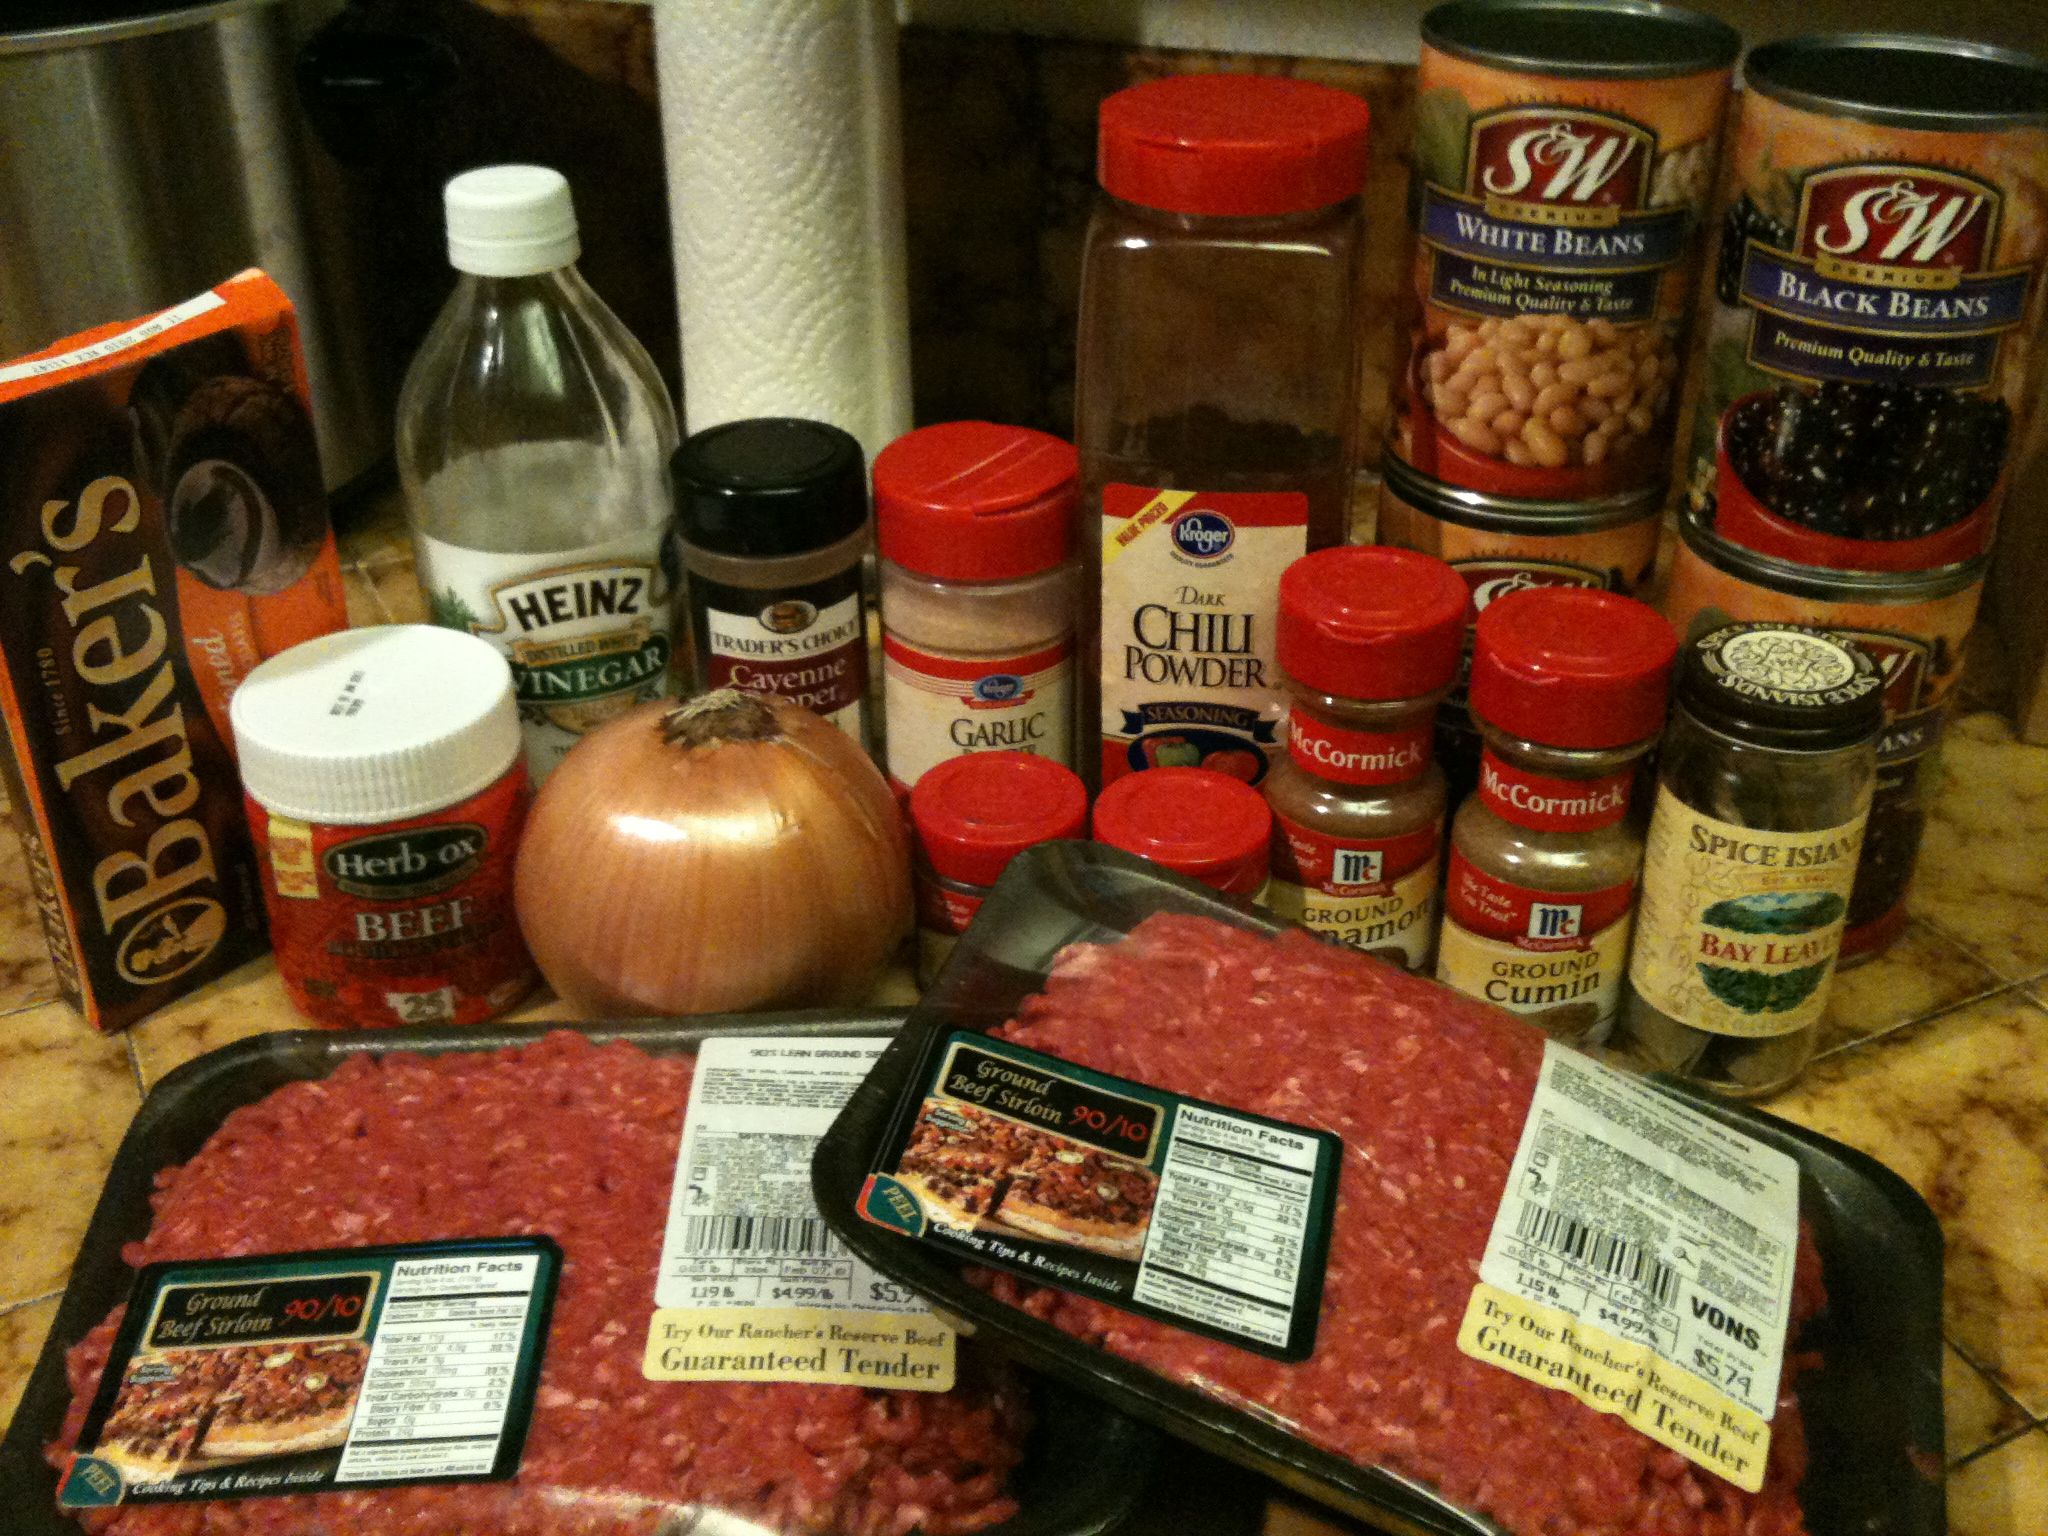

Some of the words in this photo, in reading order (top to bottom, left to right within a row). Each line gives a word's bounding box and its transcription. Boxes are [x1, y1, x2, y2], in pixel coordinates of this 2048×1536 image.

[1483, 122, 1638, 201] S&W
[1456, 211, 1546, 253] WHITE
[1553, 229, 1646, 255] BEANS
[1814, 179, 1984, 262] S&W
[1450, 279, 1511, 304] Premium
[1516, 294, 1574, 312] Quality
[1490, 268, 1530, 291] Light
[1535, 276, 1614, 295] Seasoning
[1777, 271, 1881, 316] BLACK
[1887, 291, 1990, 319] BEANS
[1774, 330, 1843, 360] Premium
[1848, 346, 1915, 369] Quality
[1179, 517, 1229, 553] Kroger
[508, 577, 643, 632] HEINZ
[714, 632, 798, 655] TRADER'S
[1133, 603, 1255, 654] CHILI
[731, 656, 847, 693] Cayenne
[1123, 645, 1266, 689] POWDER
[10, 476, 220, 936] Baker's
[1147, 704, 1249, 728] SEASONING
[950, 712, 1045, 747] GARLIC
[1290, 719, 1423, 771] McCormick
[1483, 761, 1625, 816] McCormick
[335, 842, 428, 878] Herb
[438, 836, 478, 866] ox
[1690, 824, 1779, 867] SPICE
[355, 897, 473, 942] BEEF
[1302, 896, 1404, 924] GROUND
[1492, 951, 1600, 980] GROUND
[1701, 932, 1757, 962] BAY
[1484, 972, 1601, 1005] Cumin
[815, 1050, 861, 1058] GROUND
[977, 1059, 1055, 1097] Ground
[950, 1073, 997, 1103] Beef
[996, 1090, 1063, 1125] Sirloin
[1068, 1106, 1148, 1142] 90/10
[1180, 1109, 1253, 1138] Nutrition
[1258, 1129, 1304, 1150] Facts
[882, 1185, 917, 1223] PEEL
[397, 1263, 471, 1277] Nutrition
[477, 1261, 523, 1273] Facts
[933, 1222, 986, 1251] Cooking
[989, 1240, 1016, 1260] Tips
[1033, 1254, 1081, 1280] Recipes
[1082, 1270, 1122, 1292] Inside
[185, 1286, 270, 1316] Ground
[281, 1293, 365, 1326] 90/10
[690, 1286, 719, 1298] 1.19
[772, 1287, 834, 1300] $4.99/lb
[158, 1315, 207, 1344] Beef
[206, 1313, 273, 1335] Sirloin
[663, 1323, 692, 1343] Try
[699, 1323, 734, 1339] Our
[739, 1323, 824, 1341] Rancher's
[829, 1324, 898, 1343] Reserve
[905, 1329, 947, 1347] Beef
[1691, 1295, 1760, 1351] VONS
[661, 1347, 826, 1373] Guaranteed
[839, 1349, 940, 1379] Tender
[1485, 1297, 1514, 1325] Try
[1519, 1313, 1555, 1342] Our
[1561, 1325, 1645, 1378] Rancher's
[1647, 1365, 1716, 1418] Reserve
[1719, 1411, 1760, 1446] Beef
[1694, 1348, 1752, 1397] $5.74
[1478, 1325, 1643, 1415] Guaranteed
[1652, 1398, 1750, 1474] Tender
[132, 1478, 186, 1497] Cooking
[188, 1476, 217, 1492] Tips
[234, 1470, 282, 1491] Recipes
